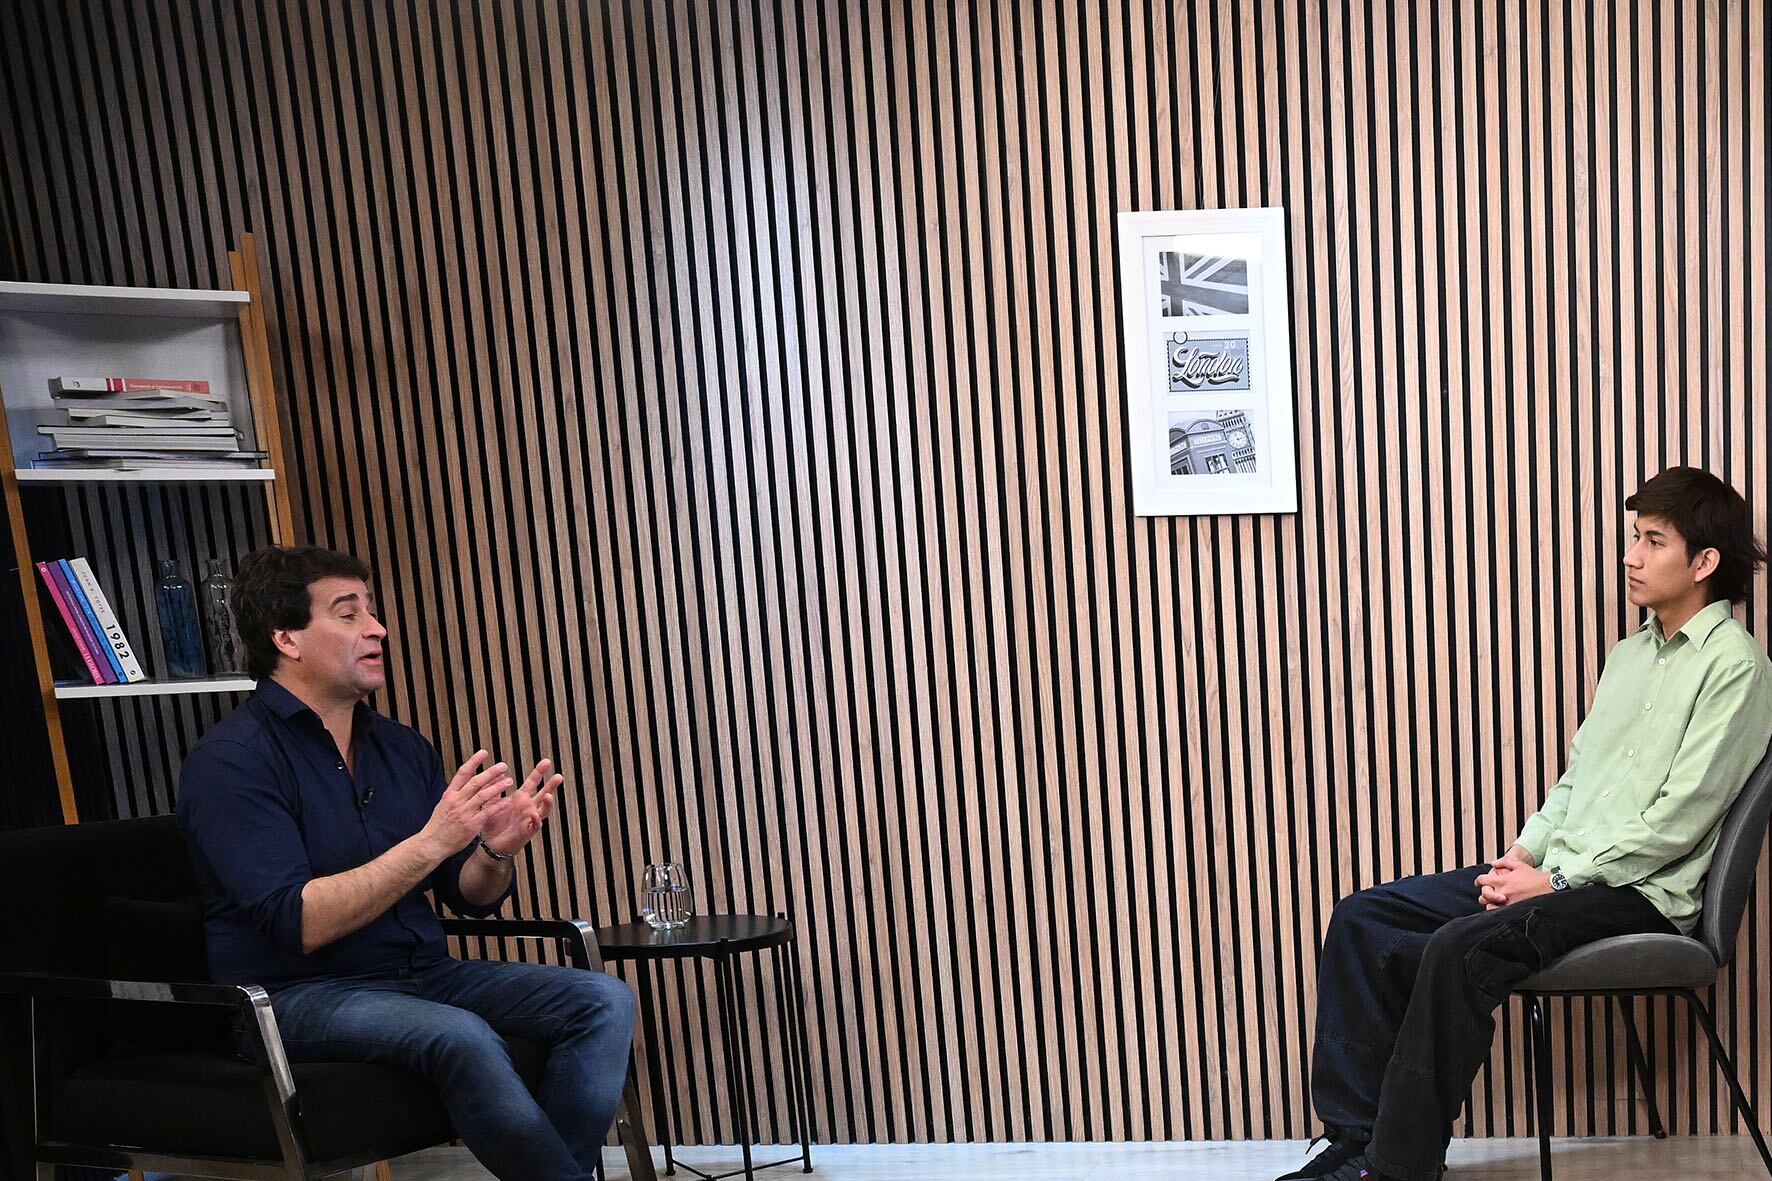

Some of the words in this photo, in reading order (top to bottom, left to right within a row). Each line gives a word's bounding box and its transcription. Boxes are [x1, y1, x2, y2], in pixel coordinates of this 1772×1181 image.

[1224, 341, 1236, 350] 20
[1172, 347, 1244, 389] London
[106, 624, 130, 660] 1982
